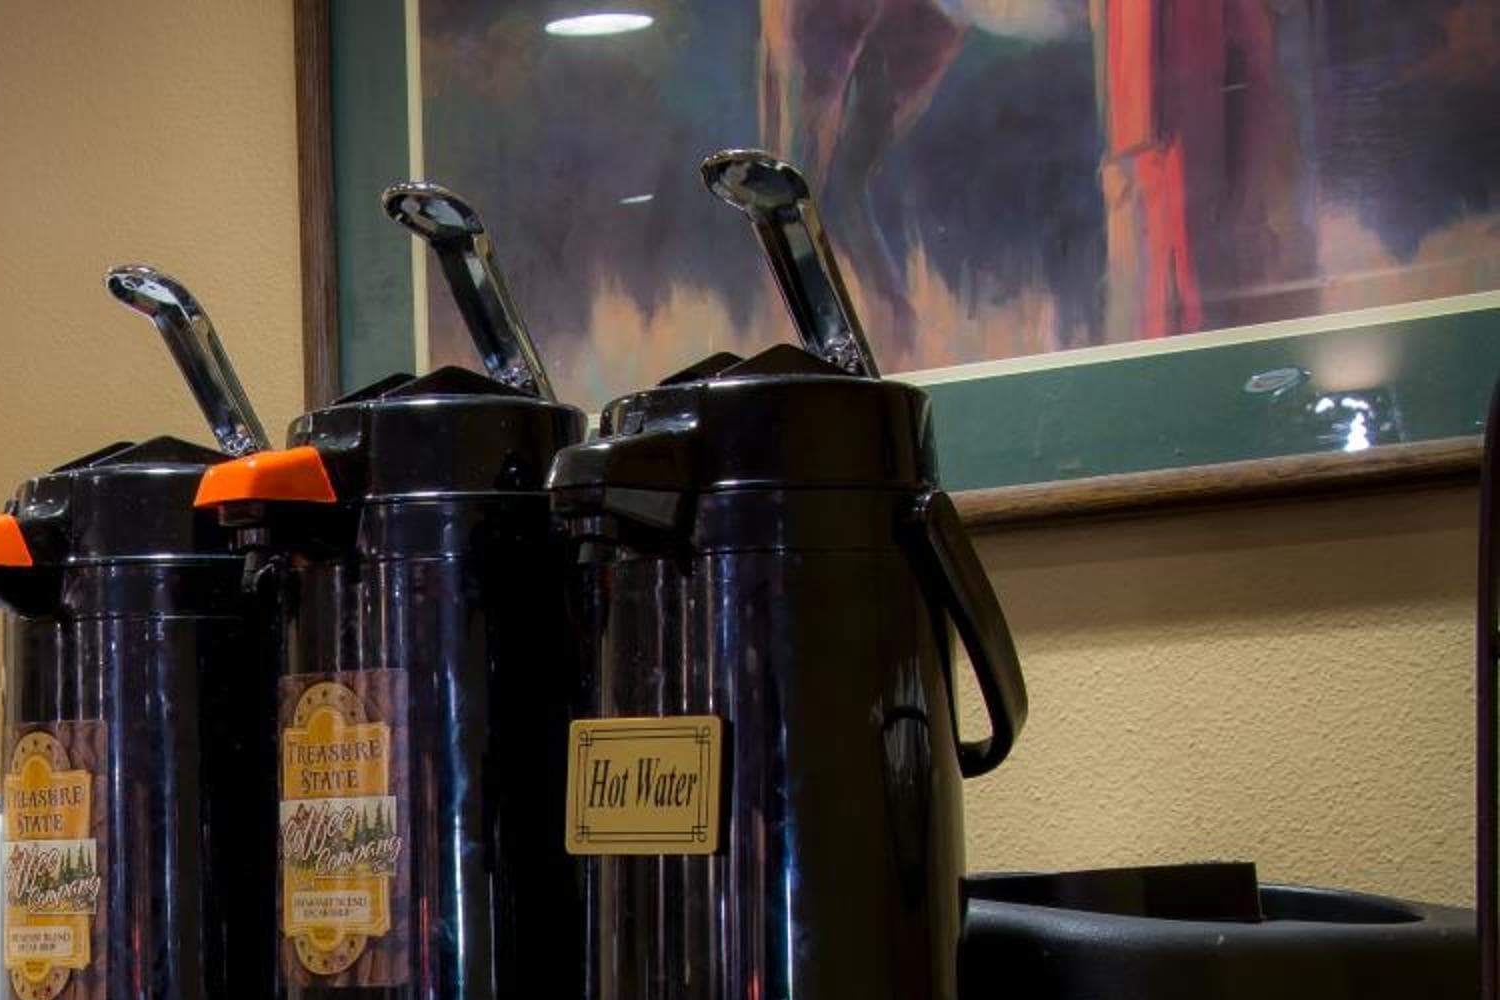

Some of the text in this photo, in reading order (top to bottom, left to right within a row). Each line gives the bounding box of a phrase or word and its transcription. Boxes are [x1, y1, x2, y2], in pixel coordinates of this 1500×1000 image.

[286, 737, 382, 765] TREASURE
[301, 767, 358, 794] STATE
[587, 757, 698, 808] Hot Water
[16, 811, 64, 835] STATE
[283, 803, 356, 862] Coffee
[315, 834, 404, 876] Company
